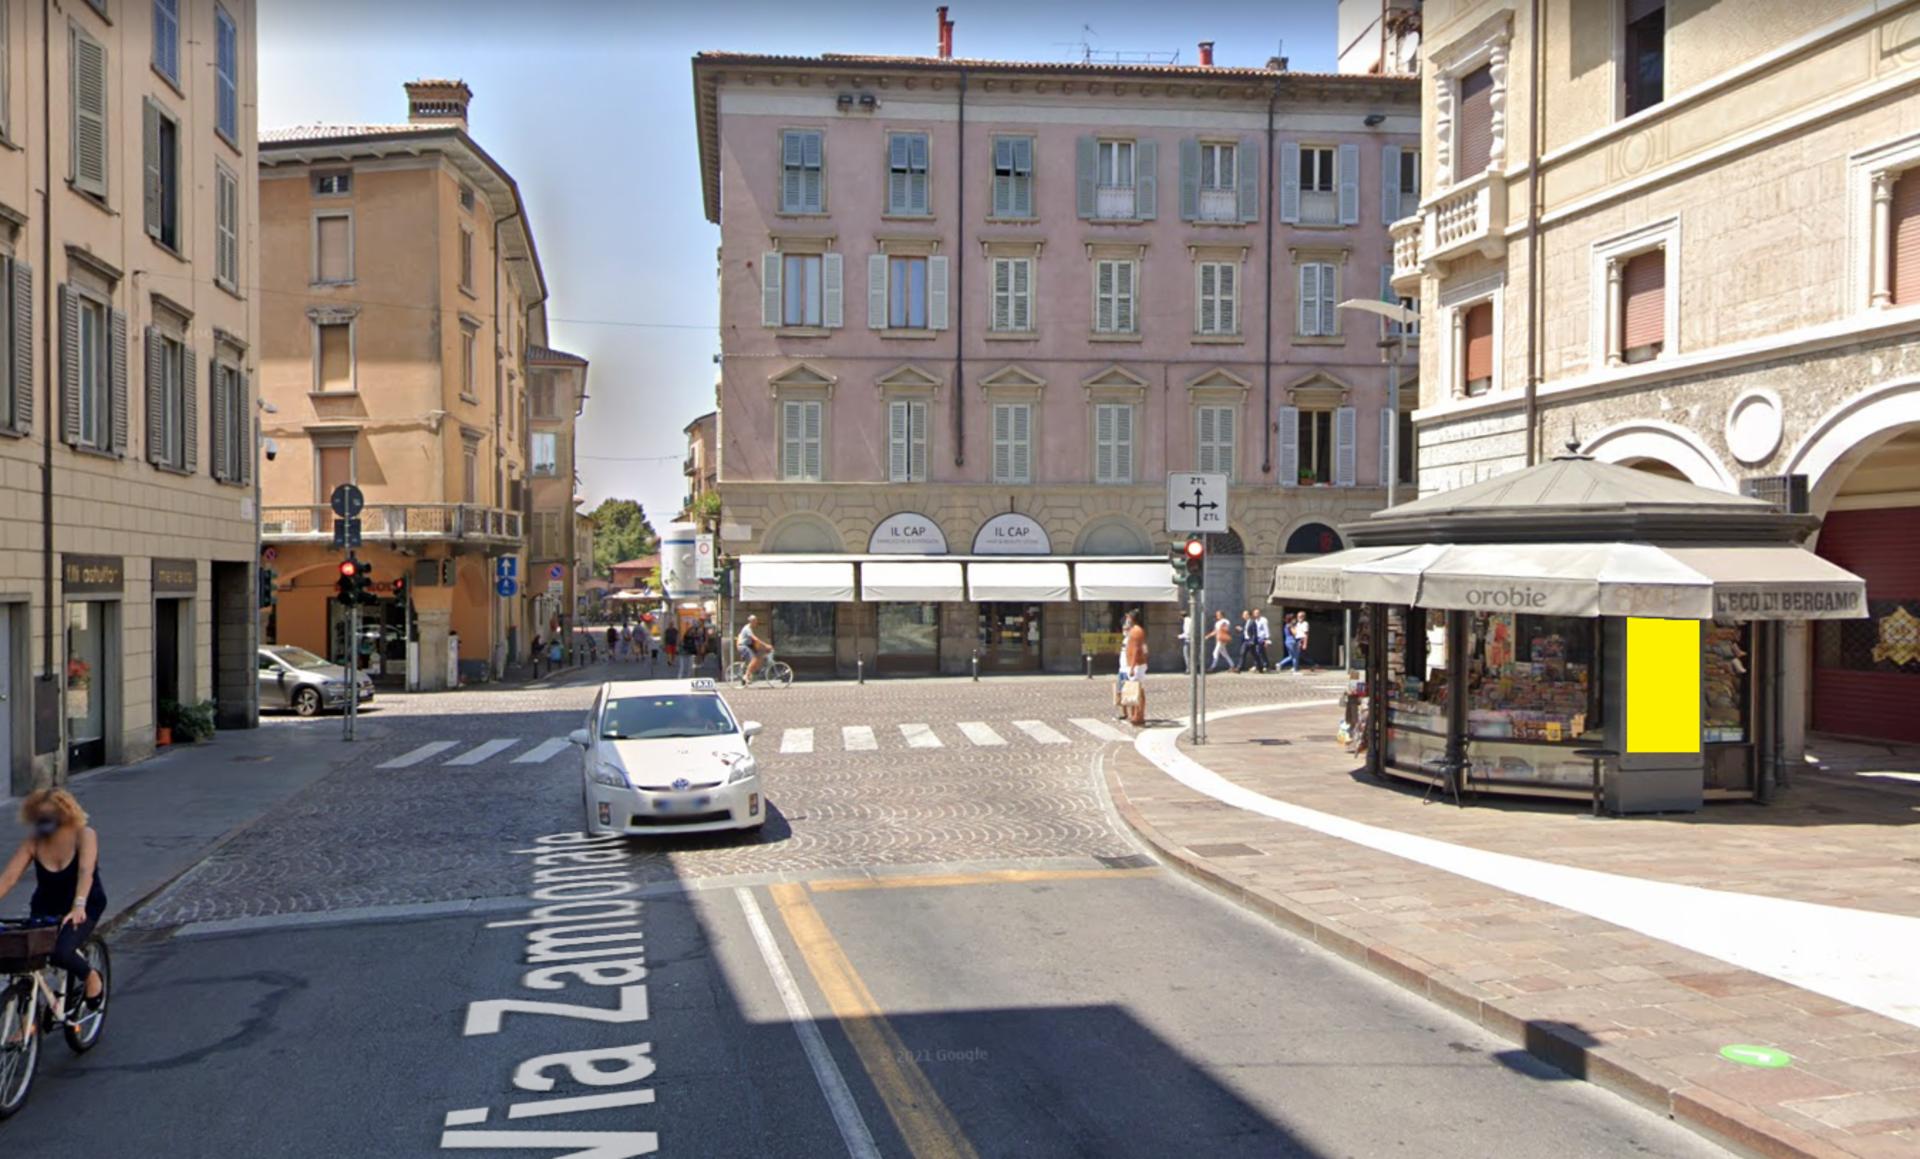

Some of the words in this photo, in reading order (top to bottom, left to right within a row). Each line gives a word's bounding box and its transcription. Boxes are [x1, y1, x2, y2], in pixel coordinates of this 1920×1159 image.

[1190, 477, 1206, 485] ZTL
[1203, 513, 1219, 521] ZTL
[891, 527, 900, 536] IL
[903, 527, 926, 536] CAP
[995, 527, 1004, 536] IL
[1007, 527, 1030, 536] CAP
[1465, 586, 1547, 608] orobie
[1716, 592, 1760, 612] L'ECO
[1763, 592, 1779, 611] DI
[1782, 592, 1859, 611] BERGAMO
